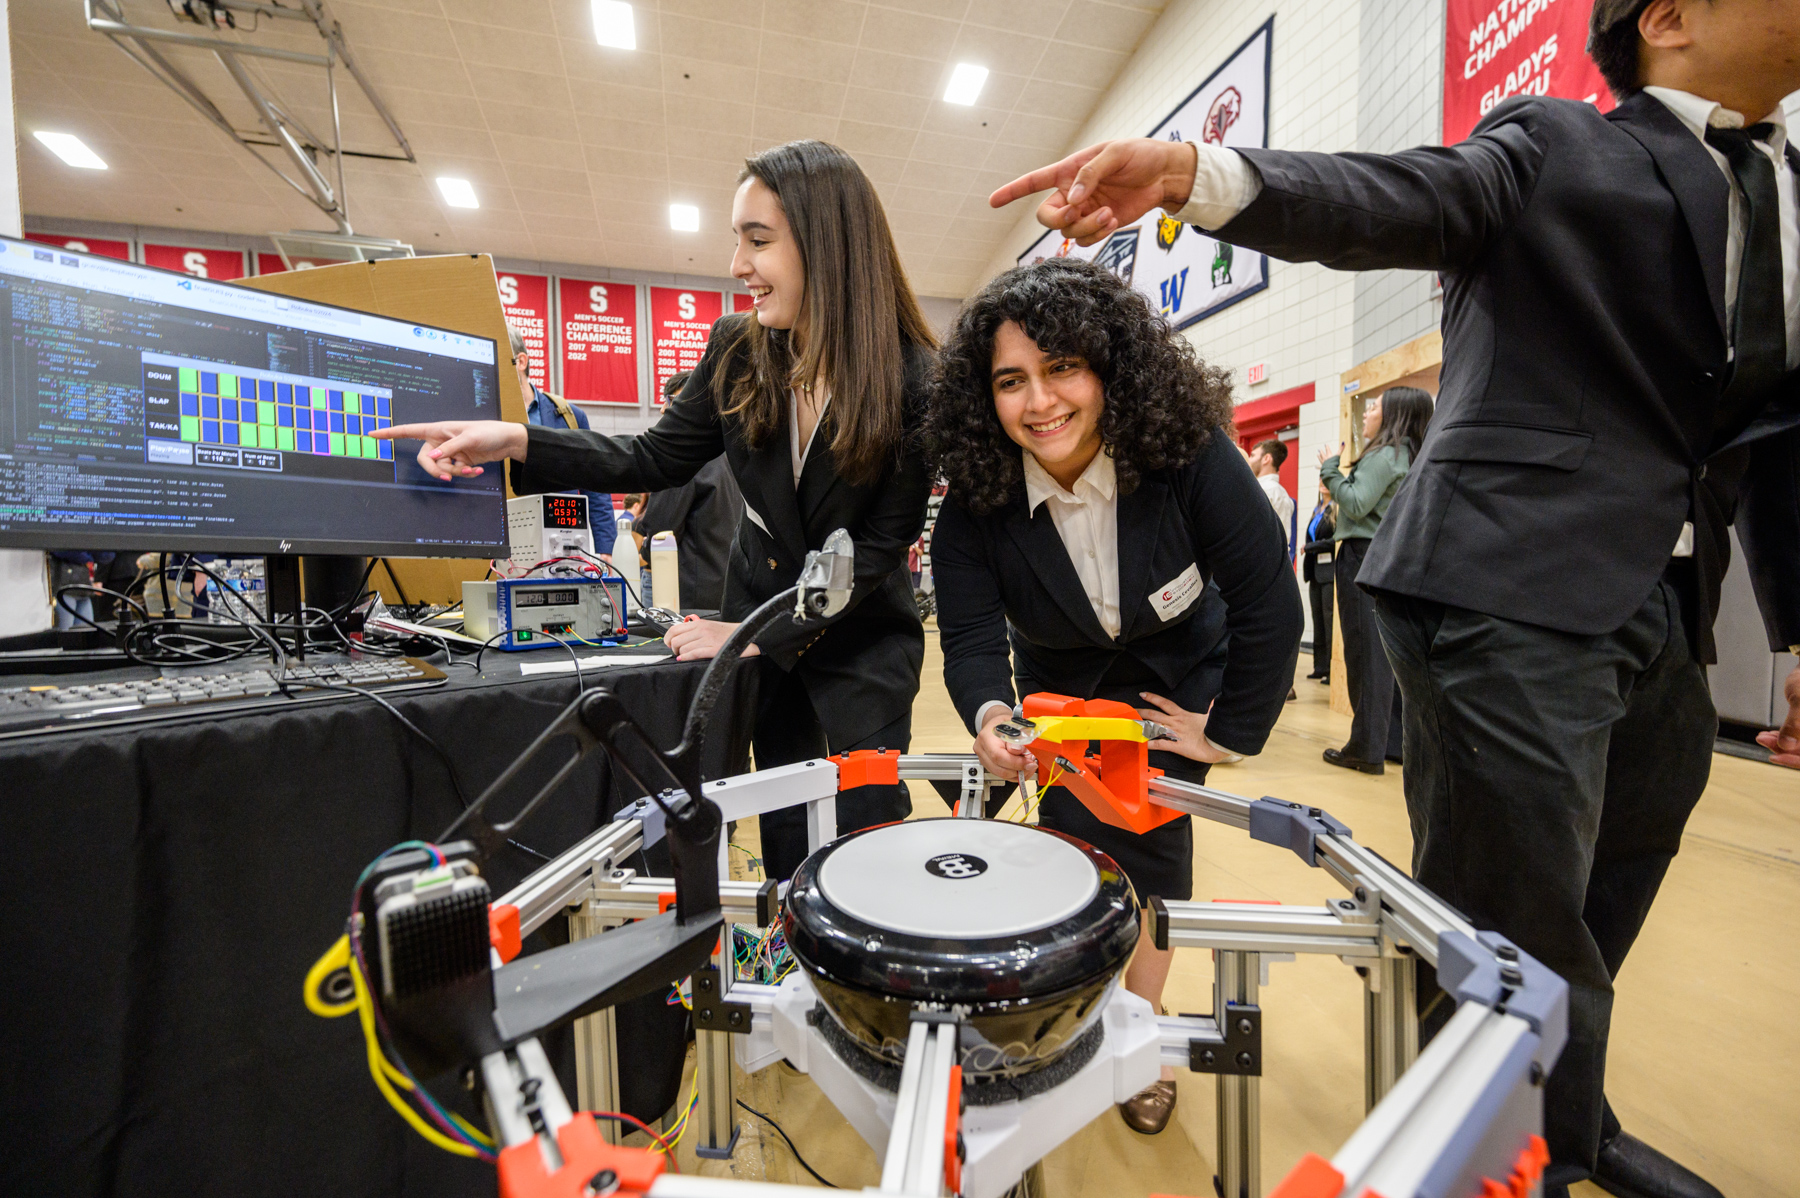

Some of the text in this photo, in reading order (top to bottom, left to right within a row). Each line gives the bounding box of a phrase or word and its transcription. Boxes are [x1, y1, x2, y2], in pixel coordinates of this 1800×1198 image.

[1480, 34, 1558, 116] GLADYS
[499, 275, 518, 305] S
[589, 285, 608, 313] S
[507, 307, 535, 317] SOCCER
[678, 293, 696, 320] S
[505, 316, 544, 328] ERENCE
[574, 313, 624, 324] MEN'S SOCCER
[566, 321, 632, 335] CONFERENCE
[663, 320, 711, 330] MEN'S SOCCER
[566, 331, 632, 345] CHAMPIONS
[671, 329, 704, 341] NCAA
[568, 342, 632, 354] 2017 2018 2021
[657, 339, 709, 350] APPEARANC
[567, 352, 587, 361] 2022
[658, 349, 675, 357] 2001
[679, 350, 697, 358] 2003
[529, 358, 545, 367] 006
[657, 358, 698, 367] 2005 2006
[147, 371, 172, 381] DOUM
[529, 368, 545, 377] 009
[1248, 363, 1264, 384] EXIT
[148, 396, 170, 405] SLAP
[149, 421, 179, 432] TAK/KA
[279, 540, 292, 553] hp
